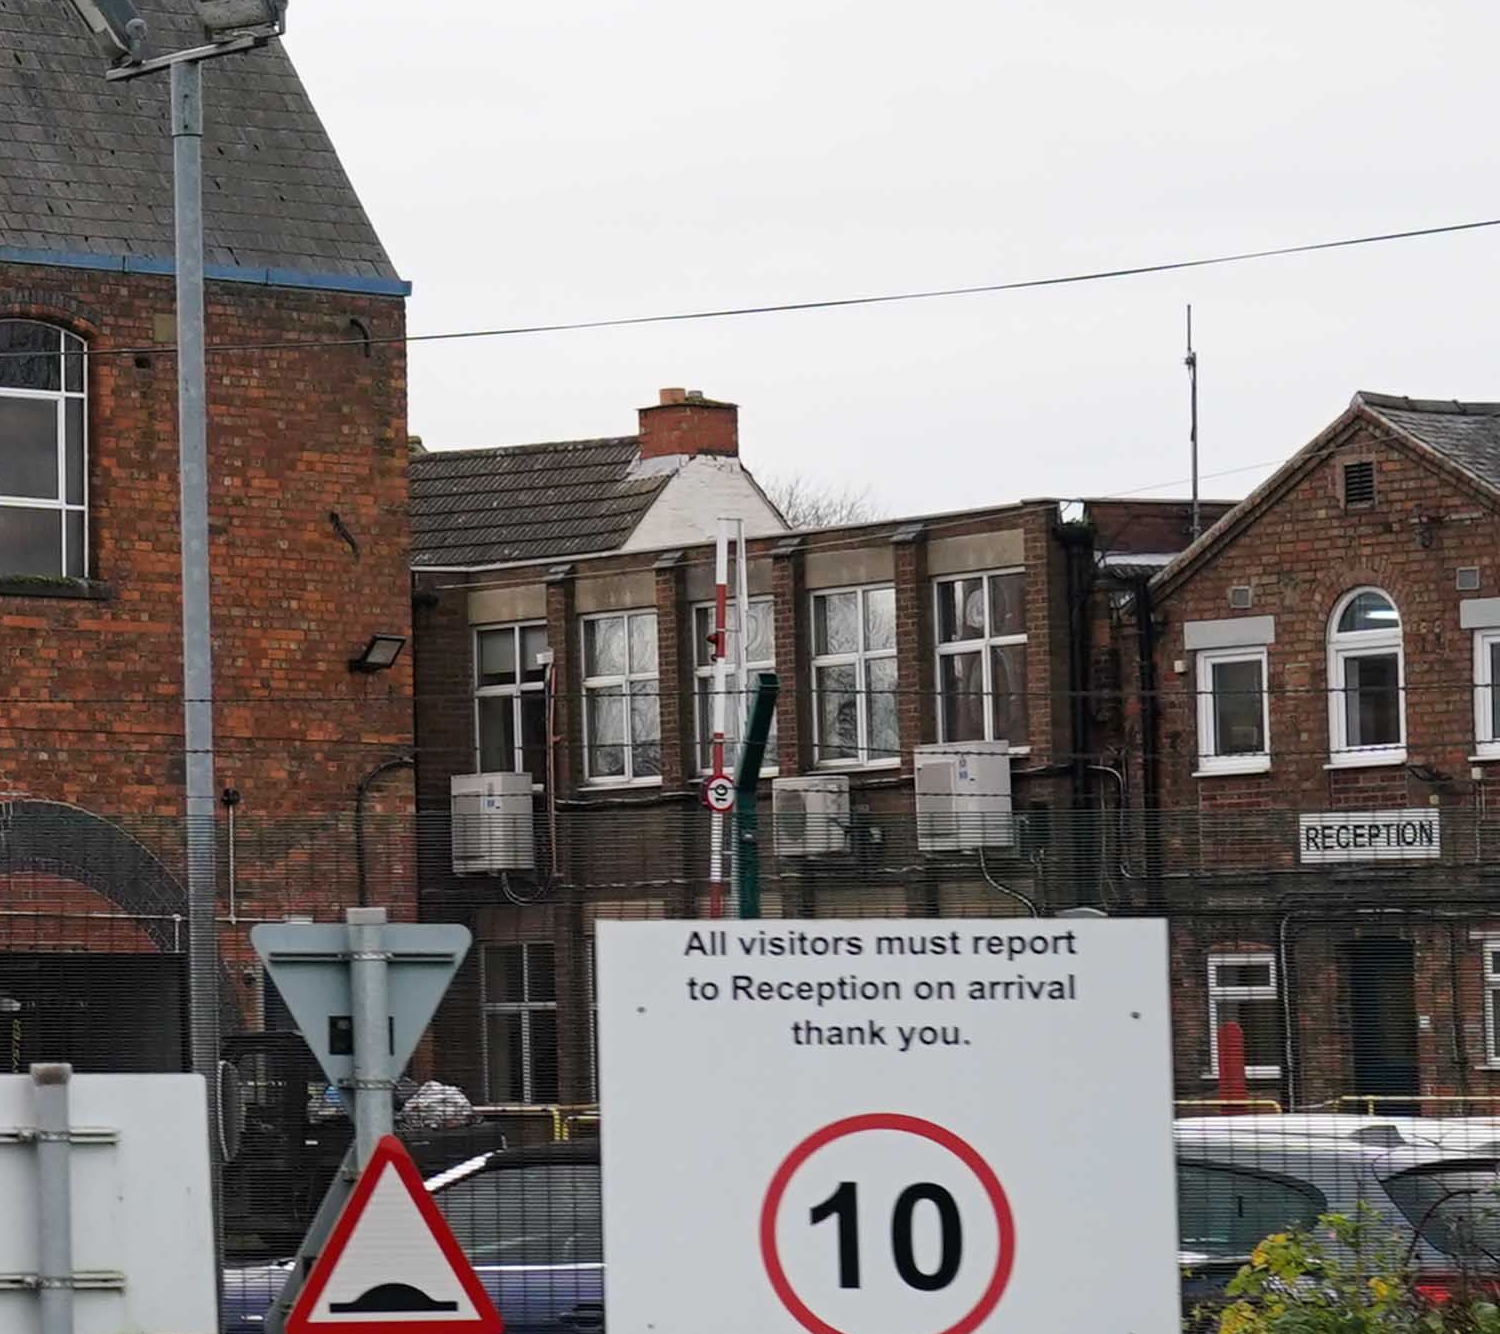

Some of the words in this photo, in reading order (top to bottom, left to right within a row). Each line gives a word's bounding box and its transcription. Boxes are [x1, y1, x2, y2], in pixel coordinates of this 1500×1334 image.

[1305, 820, 1433, 851] RECEPTION
[684, 930, 727, 956] All
[738, 930, 863, 956] visitors
[876, 931, 961, 956] must
[972, 930, 1077, 962] report
[686, 977, 719, 1001] to
[731, 974, 901, 1007] Reception
[913, 980, 956, 1001] on
[968, 974, 1076, 1001] arrival
[791, 1019, 887, 1046] thank
[897, 1026, 971, 1053] you.
[809, 1181, 963, 1292] 10
